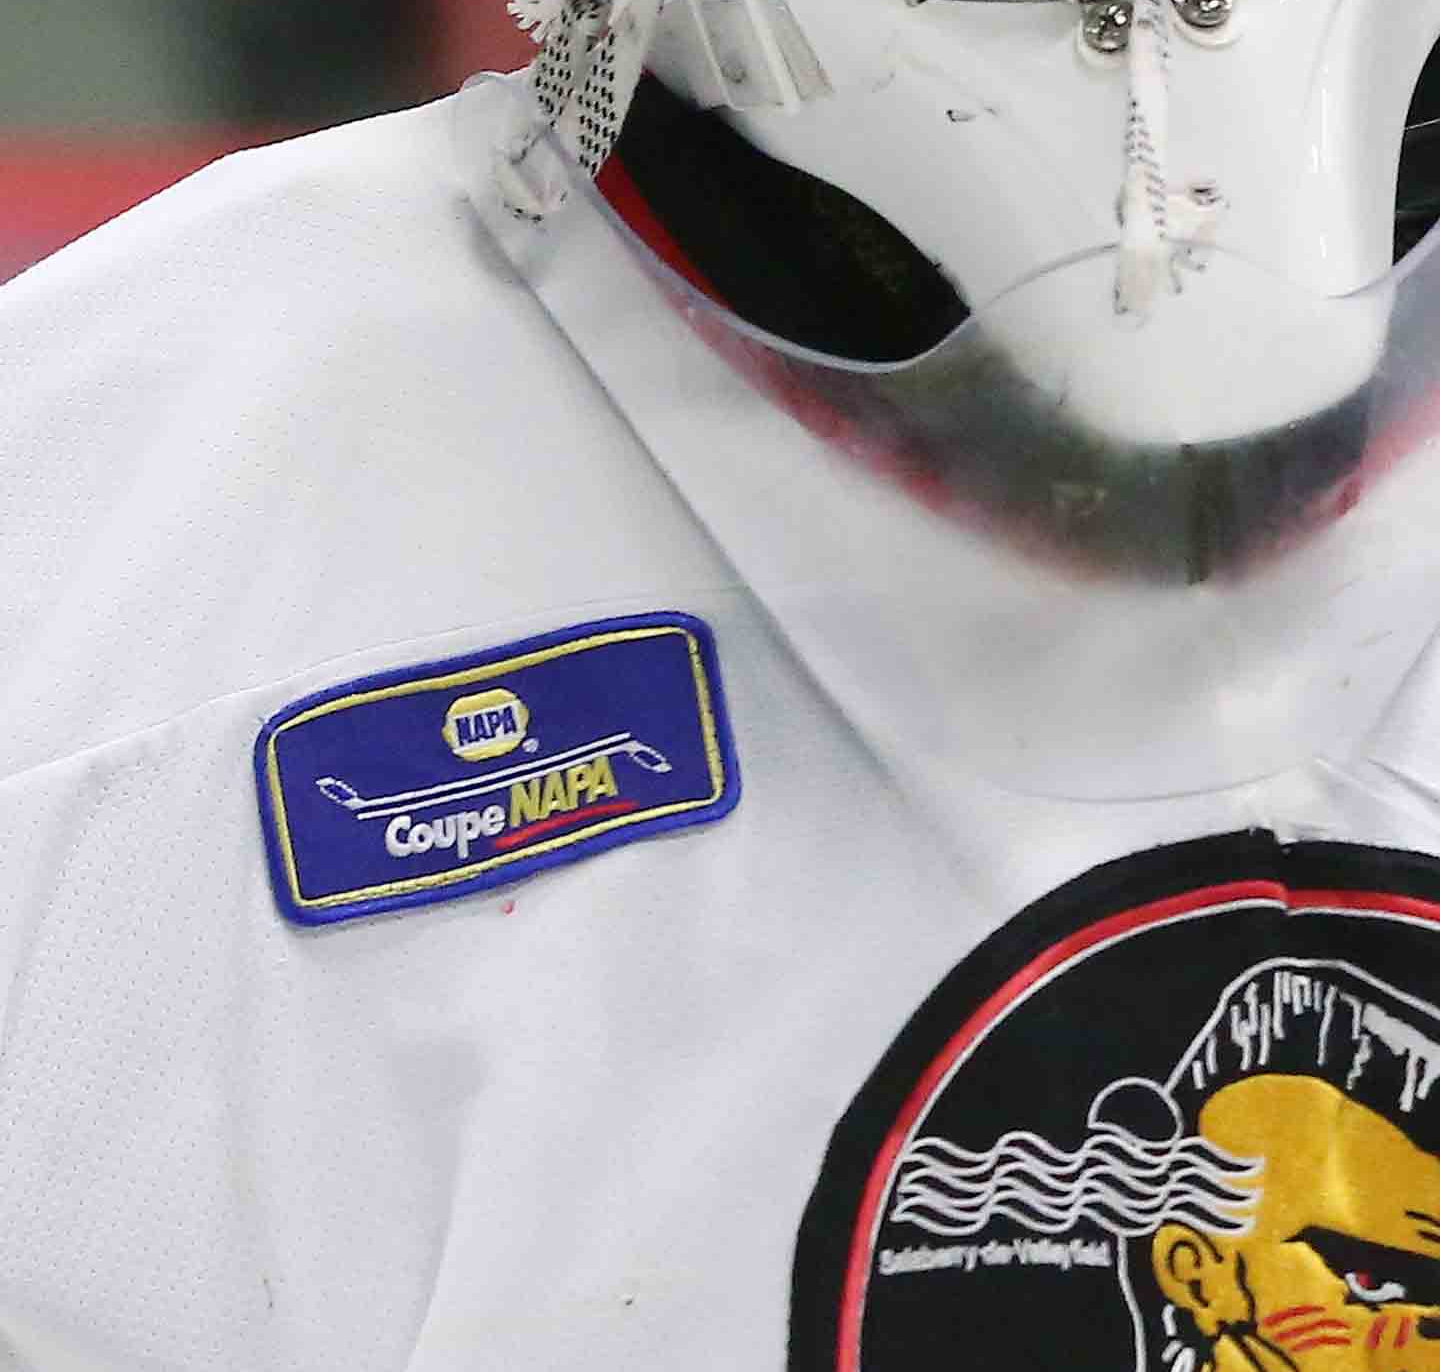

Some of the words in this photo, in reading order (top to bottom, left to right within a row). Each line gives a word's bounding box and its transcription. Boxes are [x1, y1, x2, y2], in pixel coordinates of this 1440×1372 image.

[454, 703, 519, 747] NAPA
[384, 803, 507, 860] Coupe
[509, 754, 620, 828] NAPA
